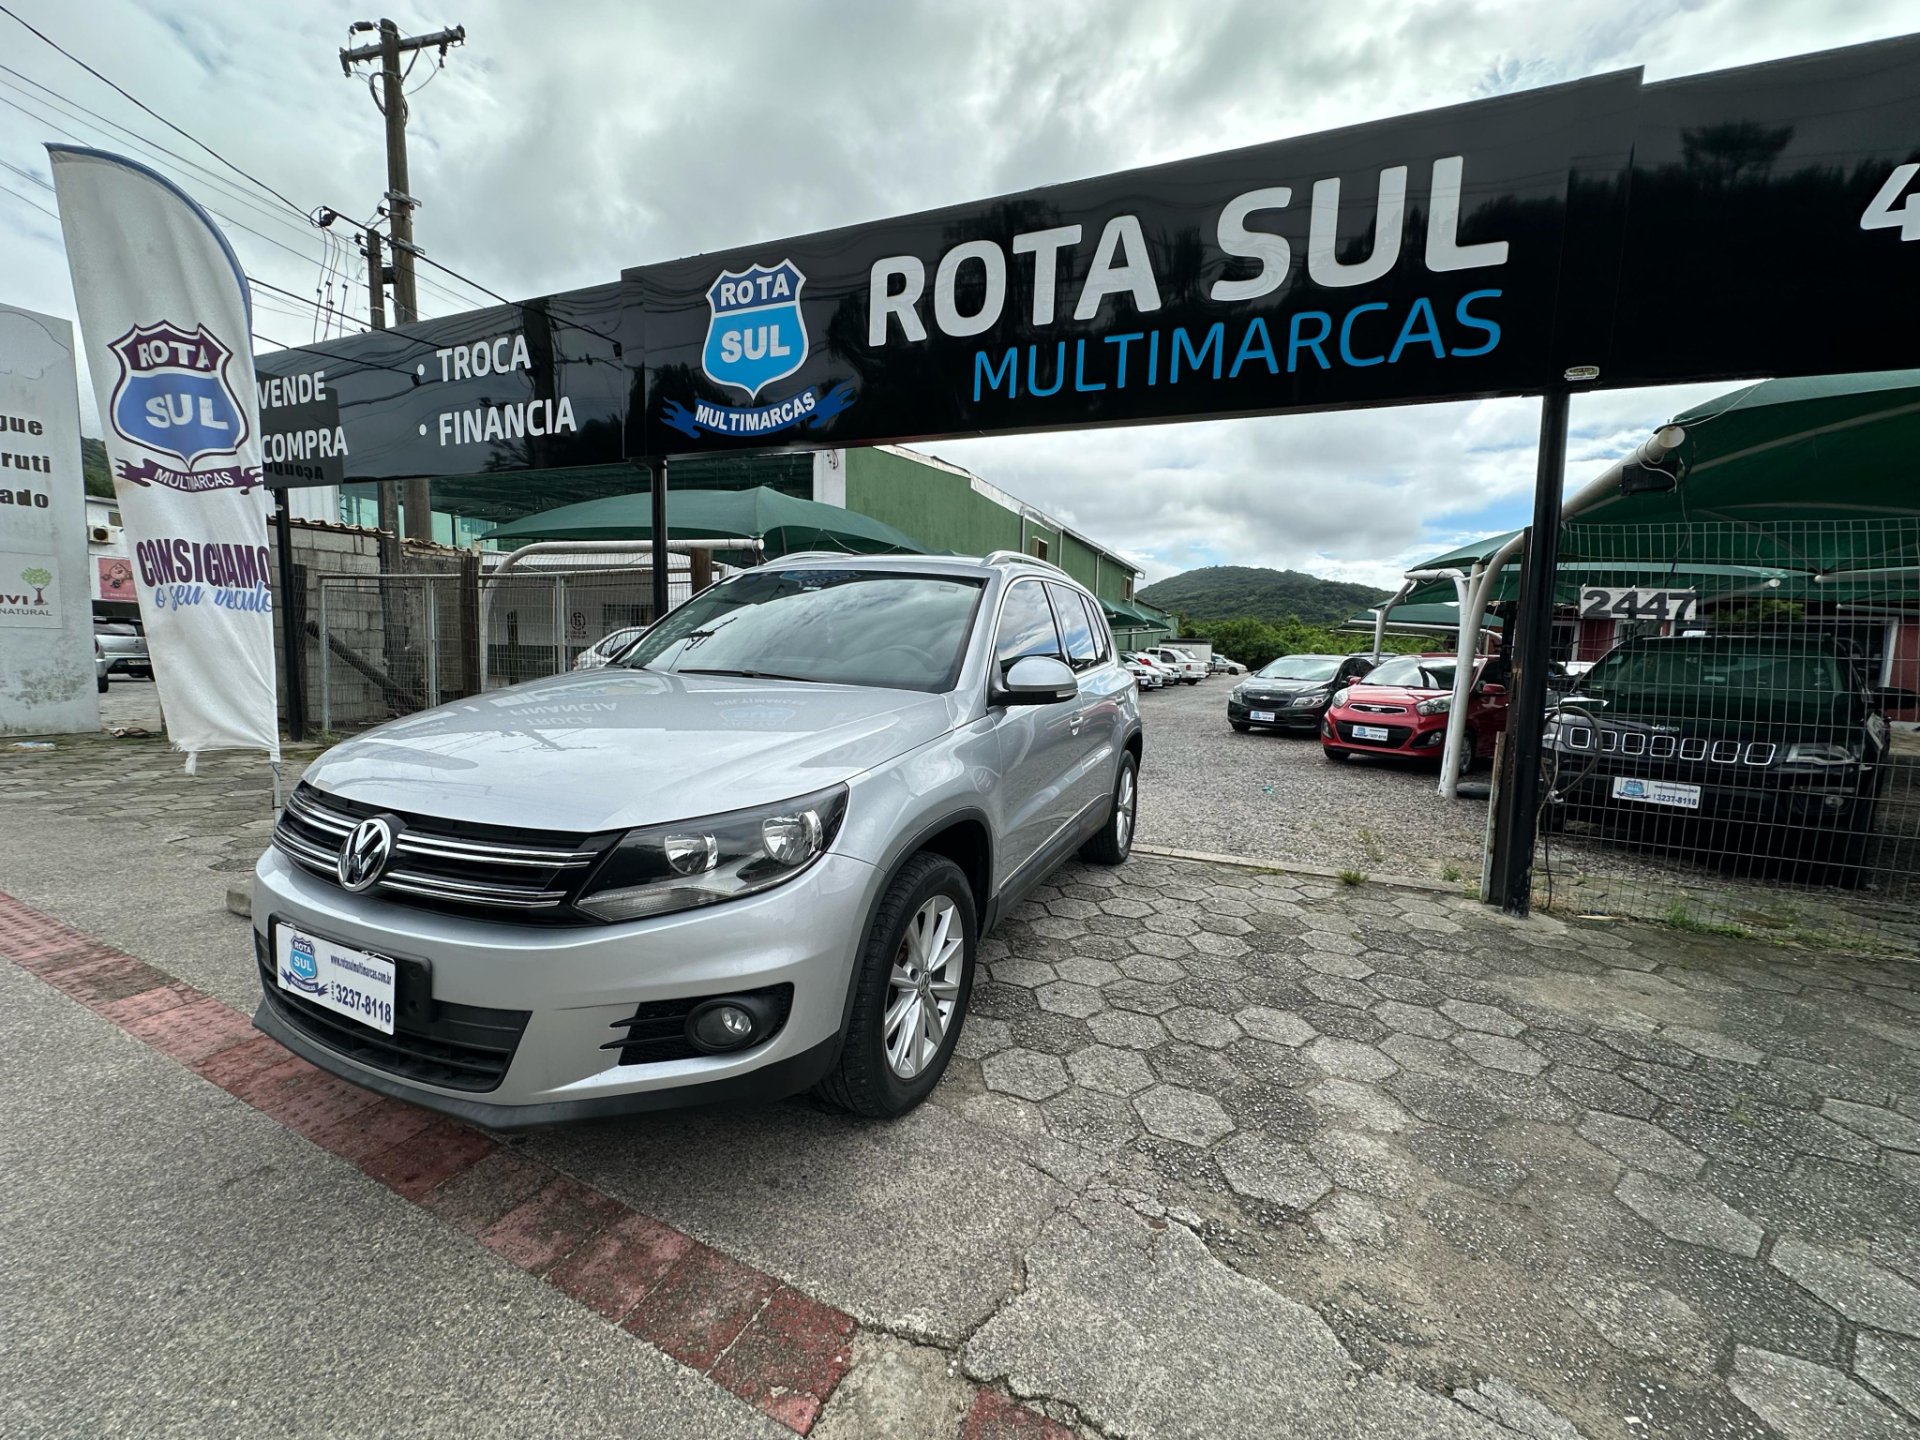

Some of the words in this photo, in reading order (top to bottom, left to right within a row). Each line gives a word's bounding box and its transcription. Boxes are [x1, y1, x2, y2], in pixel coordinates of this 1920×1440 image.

[868, 214, 1162, 347] ROTA
[1210, 155, 1509, 302] SUL
[720, 273, 791, 307] ROTA
[137, 339, 212, 369] ROTA
[436, 334, 532, 382] TROCA
[720, 325, 791, 364] SUL
[972, 288, 1503, 401] MULTIMARCAS
[256, 371, 327, 410] VENDE
[145, 393, 229, 430] SUL
[438, 396, 577, 446] FINANCIA
[695, 391, 817, 432] MULTIMARCAS
[261, 426, 349, 464] COMPRA
[154, 468, 235, 490] MULTIMARCAS
[169, 584, 205, 611] seu
[1581, 589, 1697, 620] 2447
[1656, 793, 1697, 806] 3237-8118
[294, 941, 312, 954] ROTA
[294, 955, 312, 972] SUL
[336, 983, 392, 1025] 3237-8118
